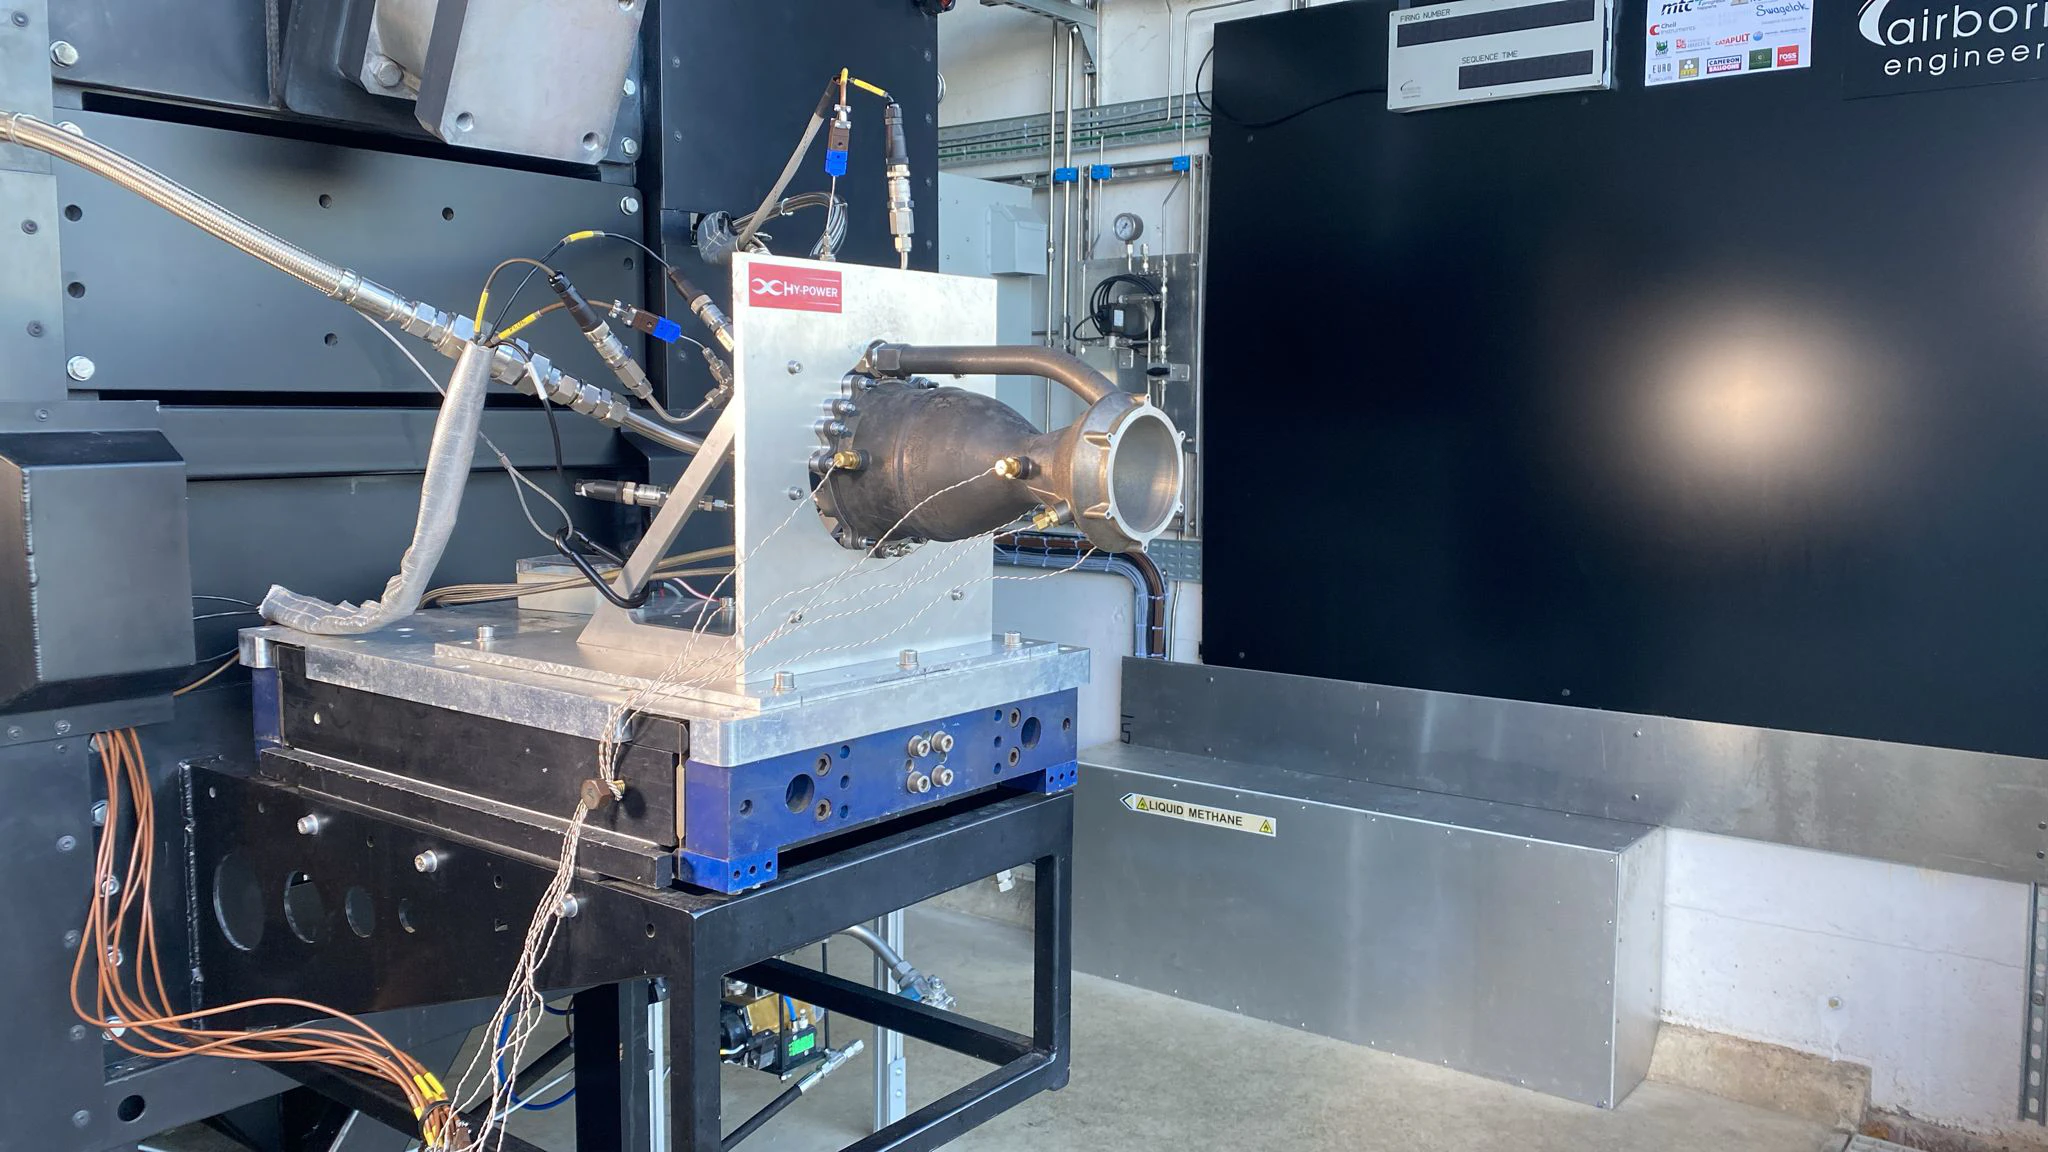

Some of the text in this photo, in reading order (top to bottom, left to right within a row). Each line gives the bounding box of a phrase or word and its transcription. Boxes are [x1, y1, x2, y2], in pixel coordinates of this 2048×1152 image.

[1661, 0, 1693, 15] mtc
[1756, 1, 1810, 17] Swagelok
[1400, 9, 1451, 22] FIRING NUMBER
[1661, 21, 1677, 29] Chell
[1887, 2, 2048, 45] airbor
[1715, 33, 1750, 46] CATAPULT
[1461, 50, 1518, 64] SEQUENCE TIME
[1709, 57, 1740, 66] CAMERON
[1779, 52, 1797, 61] ross
[1884, 43, 2045, 76] engineer
[1652, 63, 1671, 74] EURO
[1709, 64, 1740, 73] BALLOONS
[783, 281, 838, 298] HY-POWER
[1149, 800, 1243, 827] LIQUID METHANE
